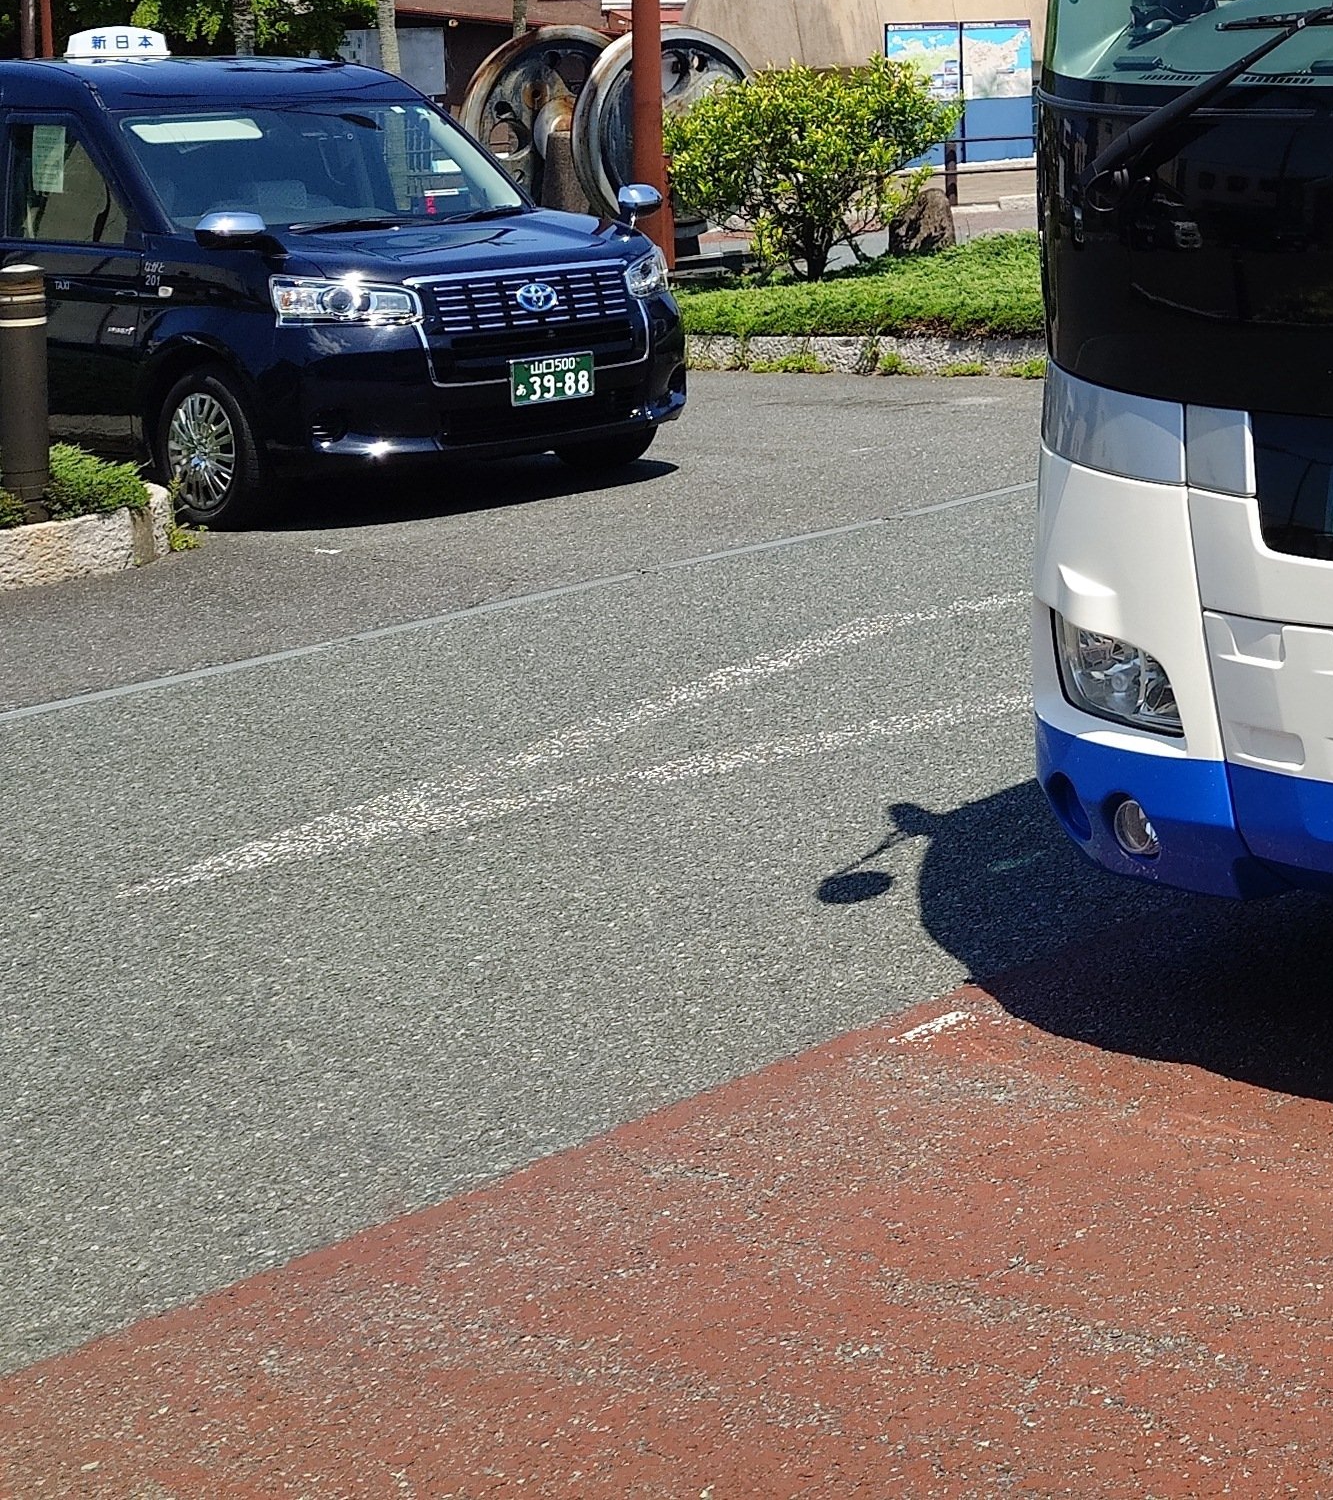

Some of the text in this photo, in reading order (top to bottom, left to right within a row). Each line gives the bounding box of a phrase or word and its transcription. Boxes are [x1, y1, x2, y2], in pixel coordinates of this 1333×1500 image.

[91, 35, 154, 50] 新日本
[55, 281, 70, 290] TAXI
[145, 275, 161, 286] 201
[530, 357, 576, 374] 山口500
[516, 370, 590, 401] あ 39-88
